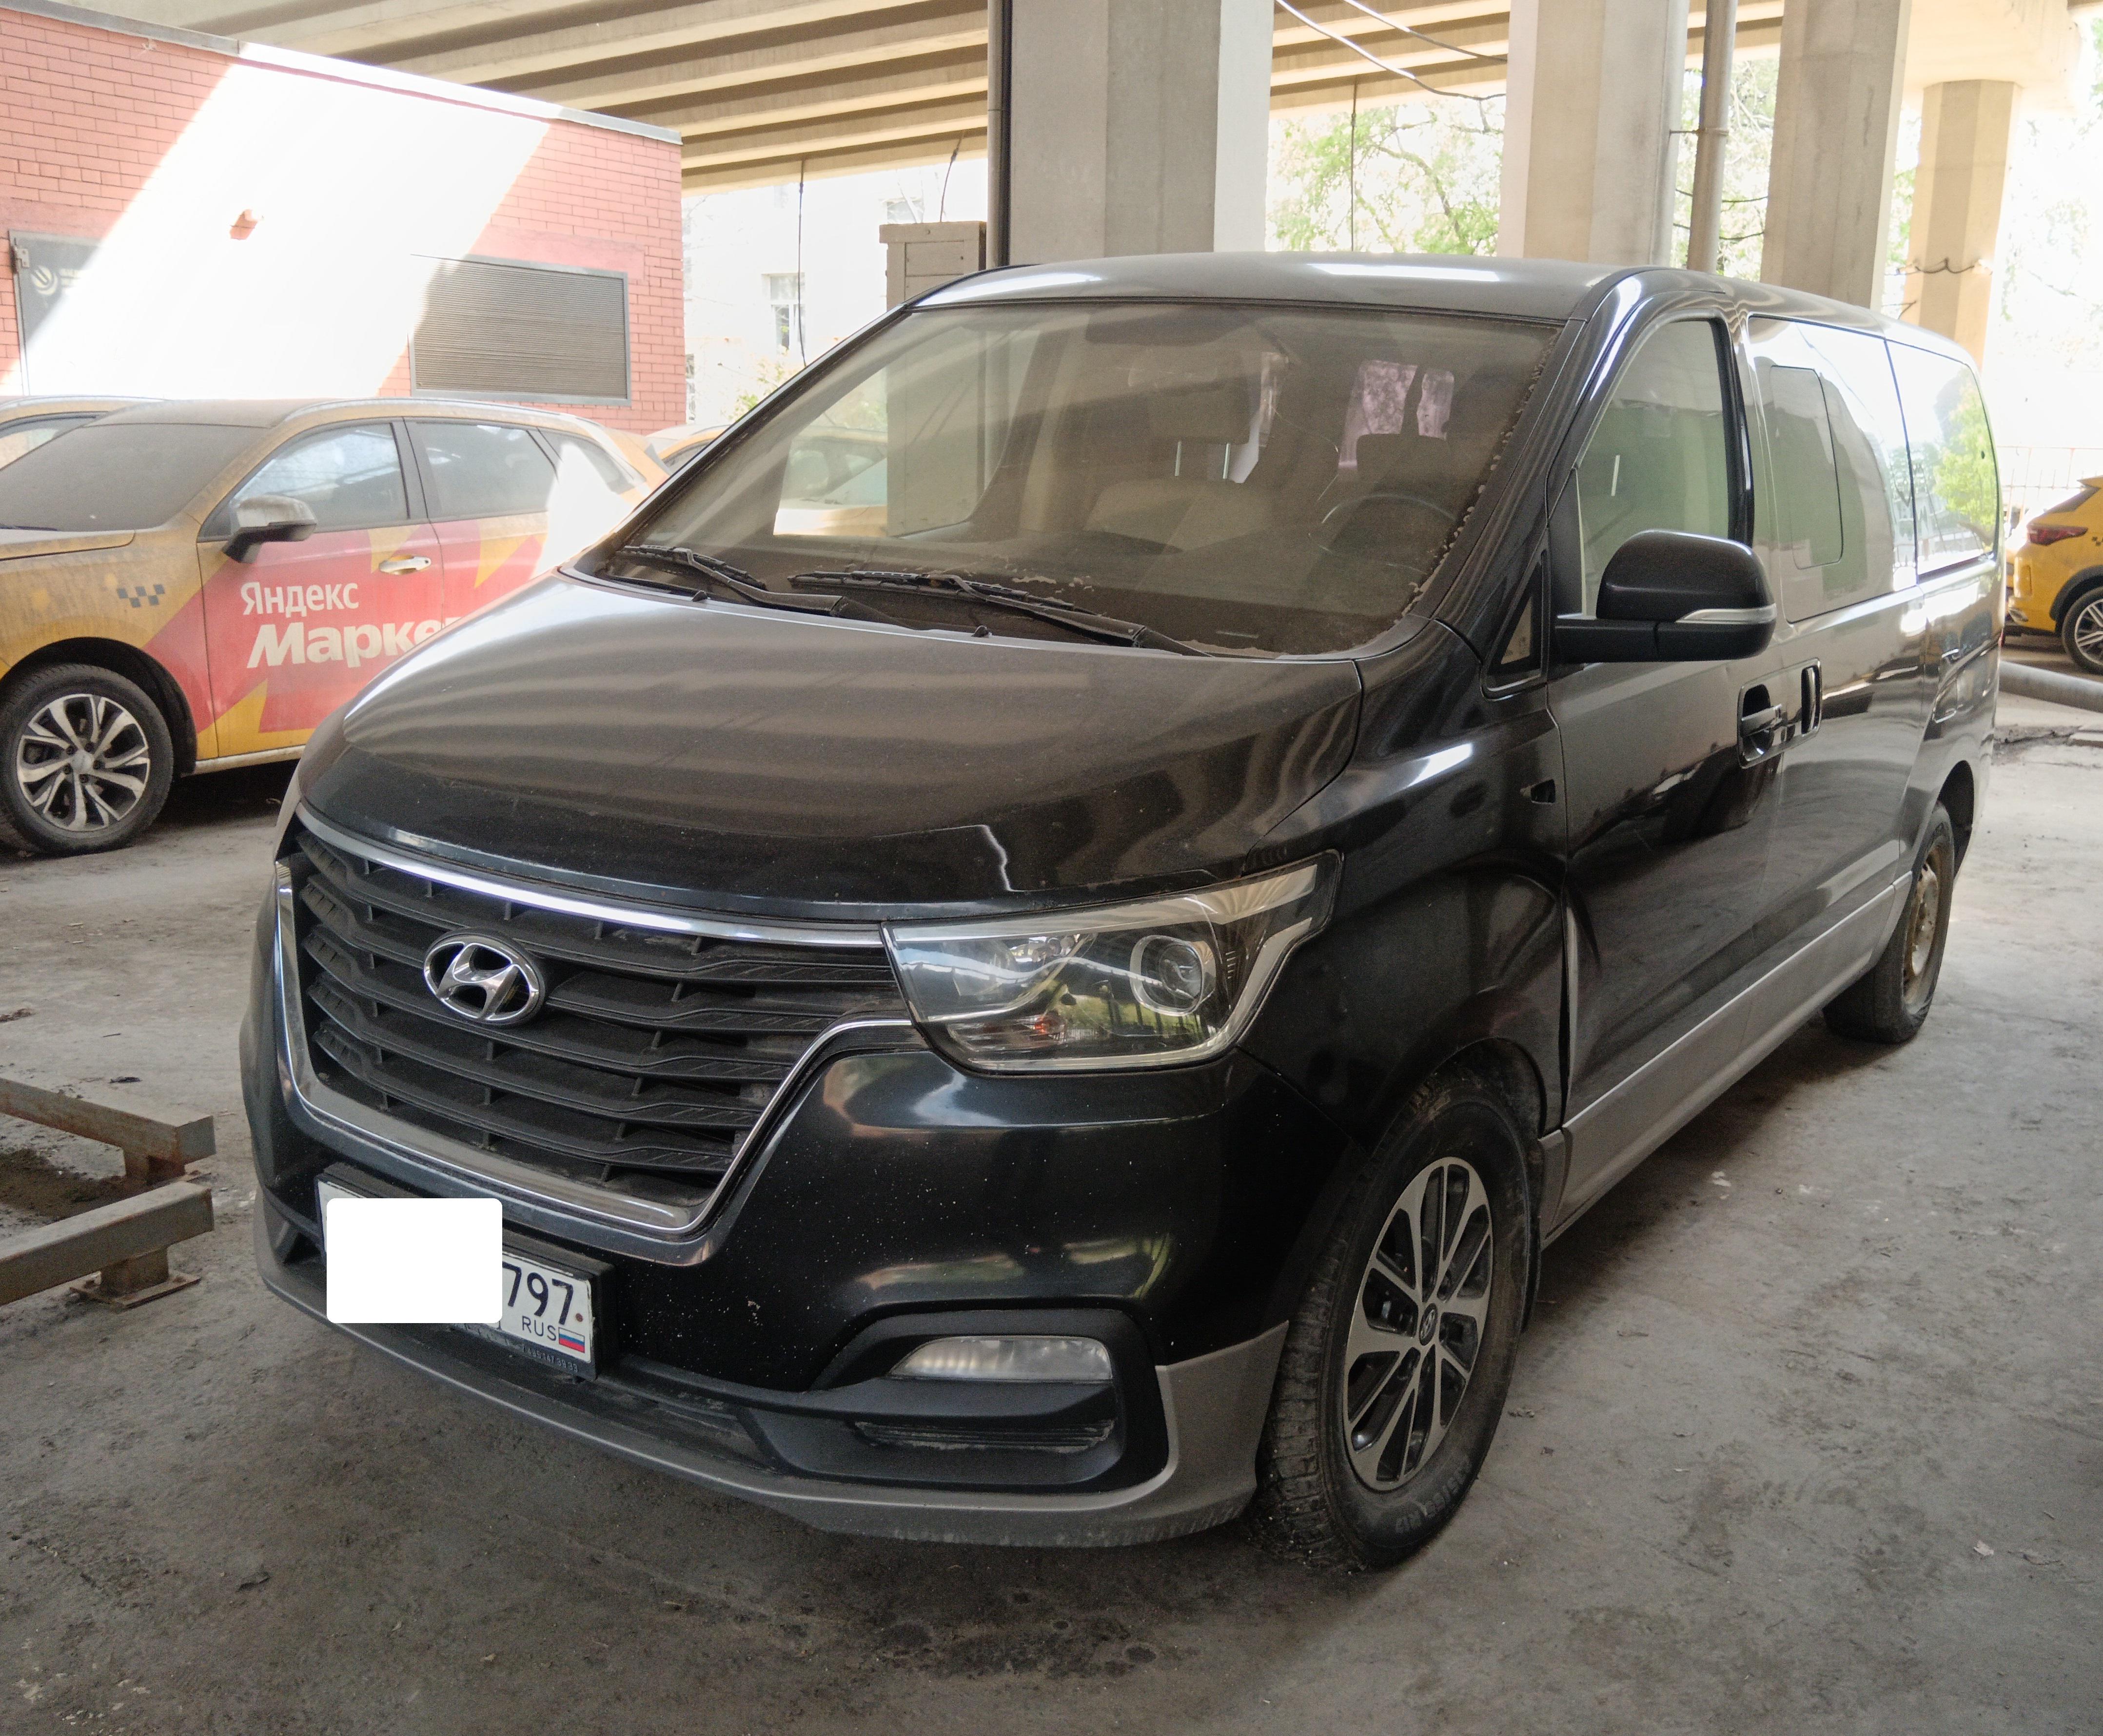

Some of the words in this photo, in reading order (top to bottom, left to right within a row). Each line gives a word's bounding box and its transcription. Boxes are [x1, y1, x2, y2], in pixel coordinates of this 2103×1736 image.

[240, 582, 359, 618] Яндекс
[247, 616, 461, 668] Марке
[502, 1261, 573, 1326] 797
[522, 1315, 557, 1341] RUS
